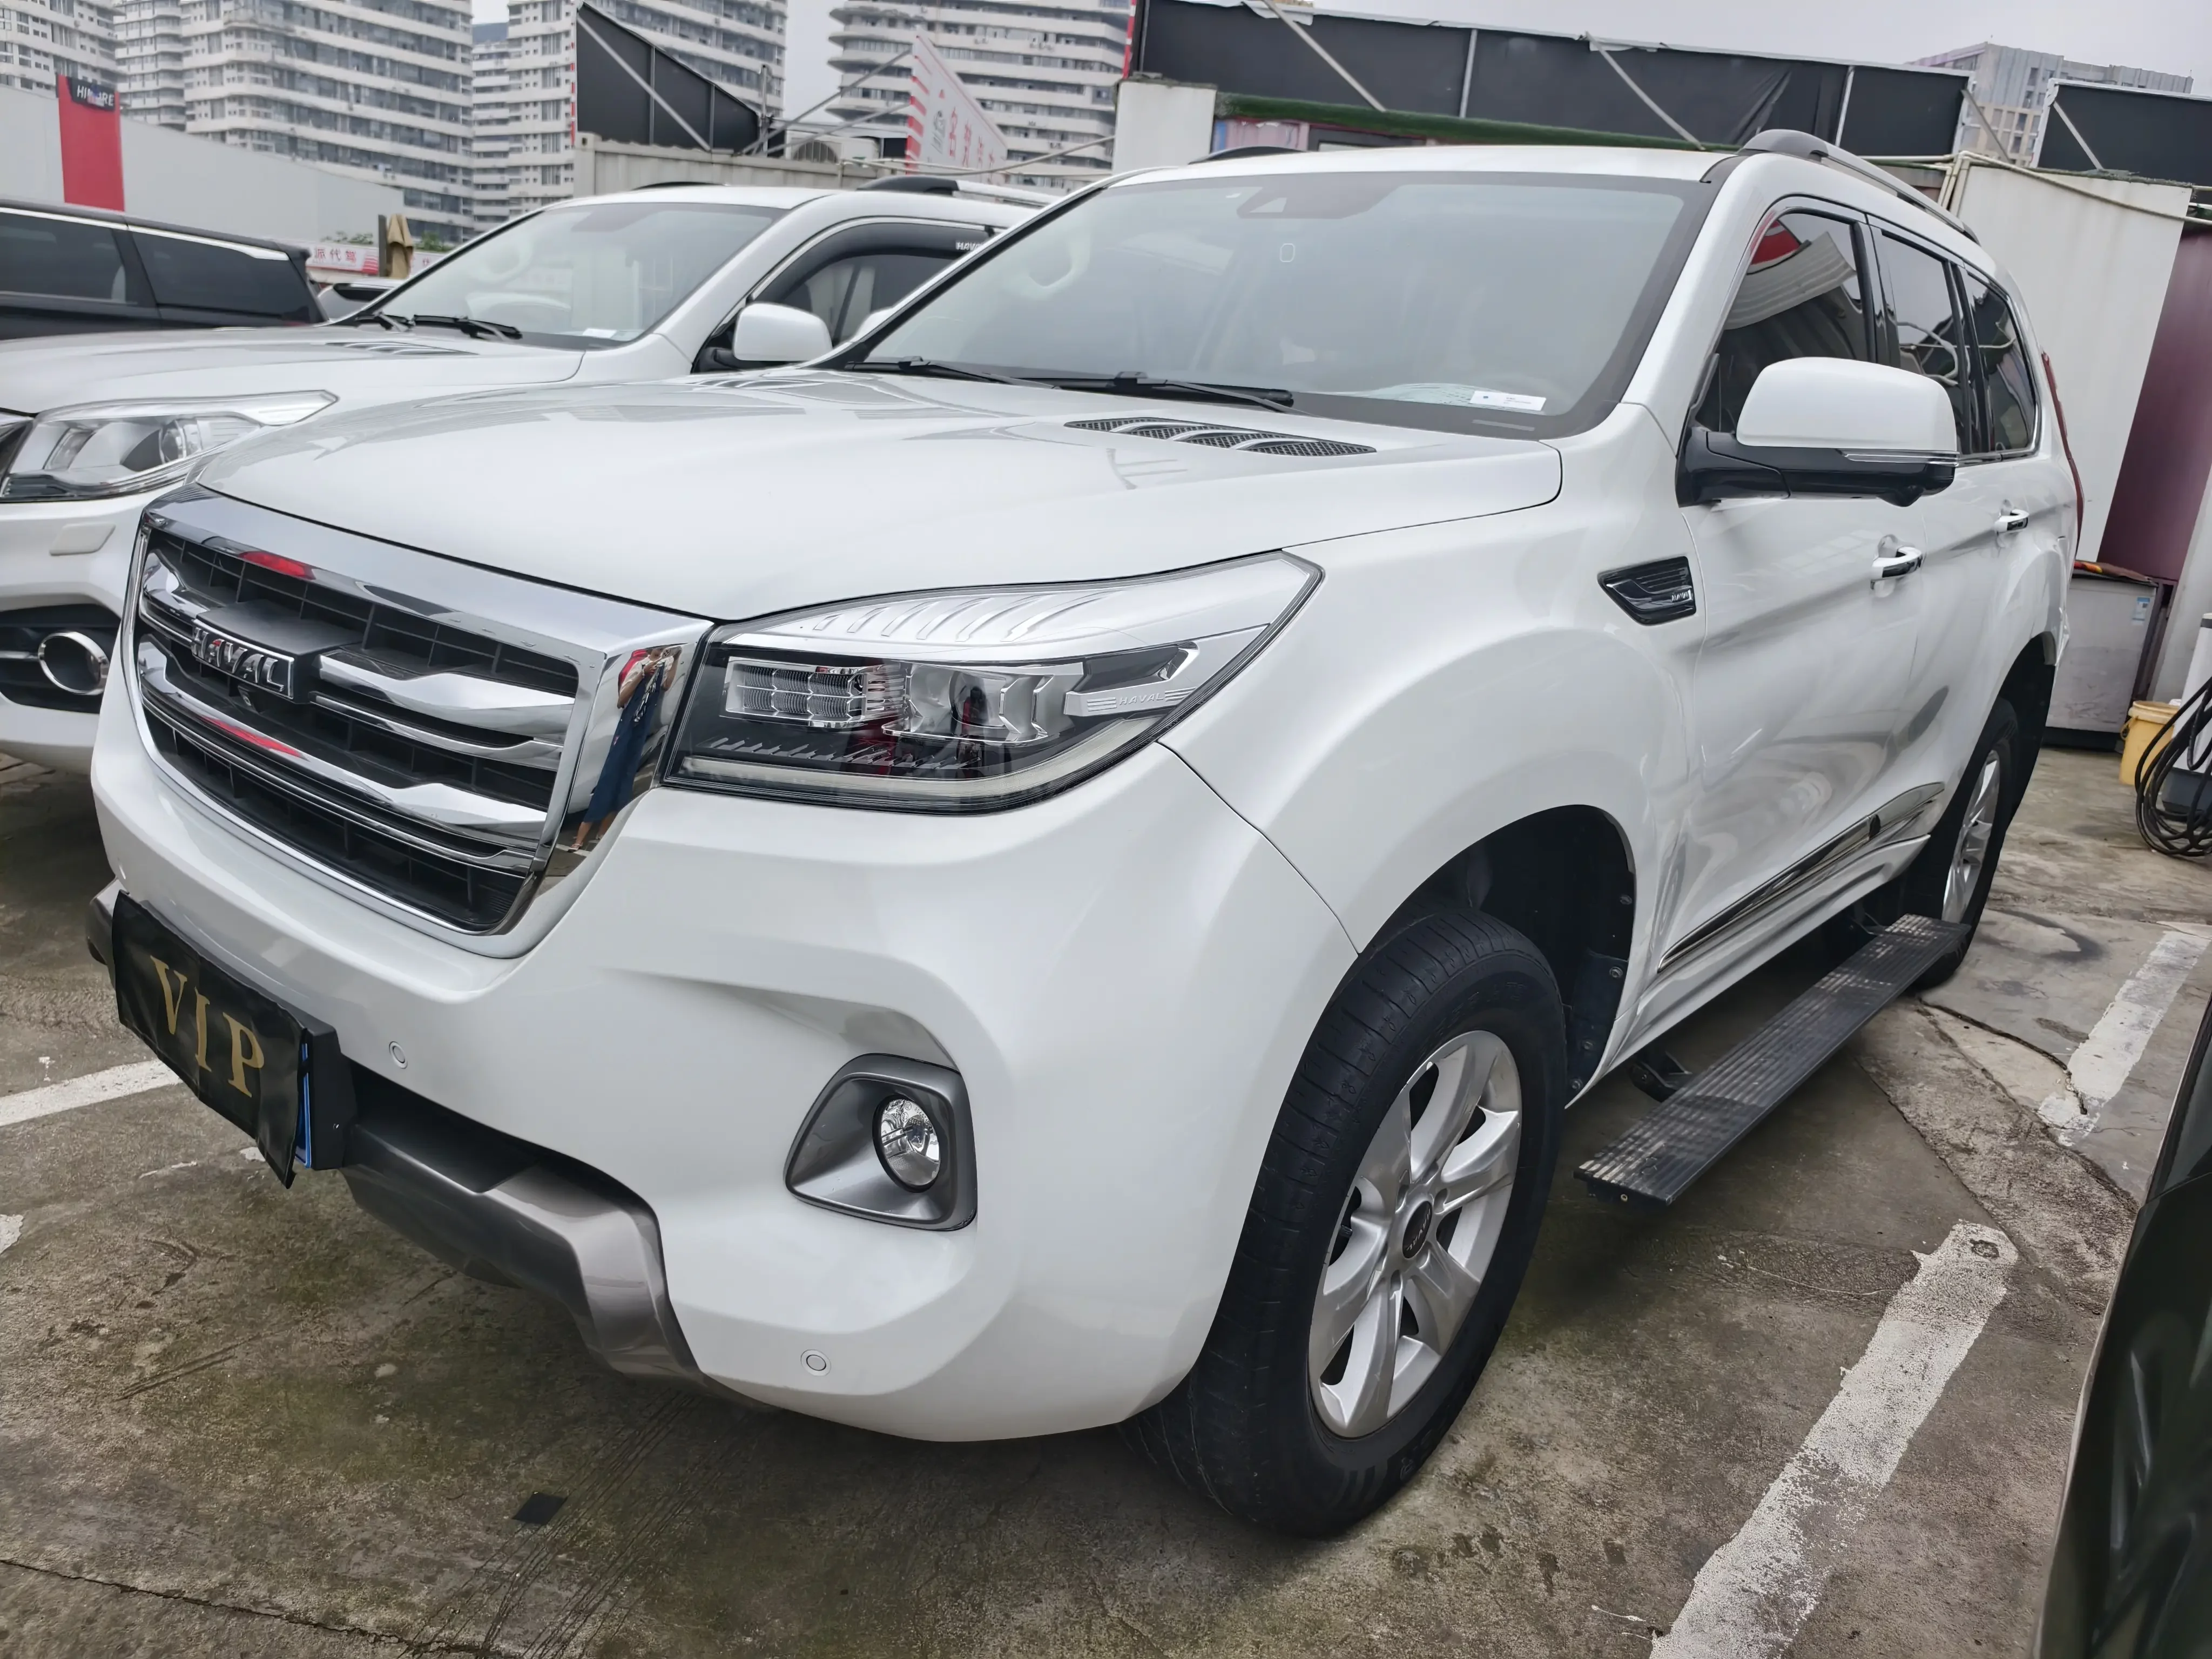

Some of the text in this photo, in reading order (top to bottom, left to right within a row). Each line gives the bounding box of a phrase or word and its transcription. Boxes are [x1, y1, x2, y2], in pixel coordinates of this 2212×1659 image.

[193, 626, 285, 692] HAVAL
[1118, 692, 1164, 706] HAVAL
[150, 955, 265, 1098] VIP
